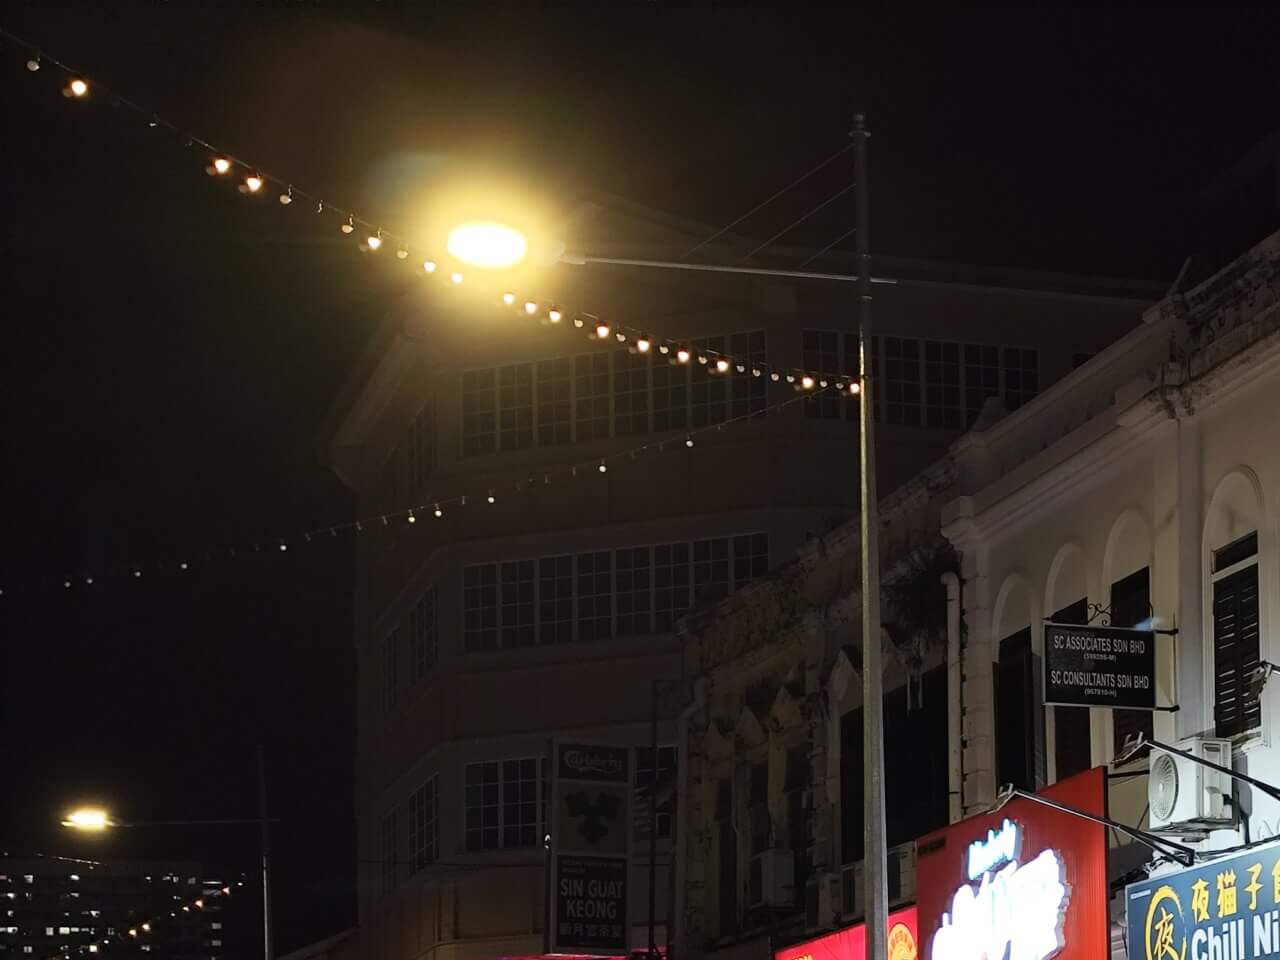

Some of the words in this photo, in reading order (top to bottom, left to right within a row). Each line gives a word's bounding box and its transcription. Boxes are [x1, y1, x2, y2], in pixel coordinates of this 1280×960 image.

[1054, 635, 1064, 649] SC
[1066, 636, 1111, 652] ASSOCIATES
[1113, 638, 1128, 653] SDN
[1129, 639, 1145, 654] BHD
[1051, 670, 1061, 684] SC
[1063, 671, 1115, 687] CONSULTANTS
[1117, 674, 1132, 688] SDN
[1133, 675, 1149, 689] BHD
[560, 878, 583, 896] SIN
[588, 879, 624, 898] GUAT
[567, 899, 616, 919] KEONG
